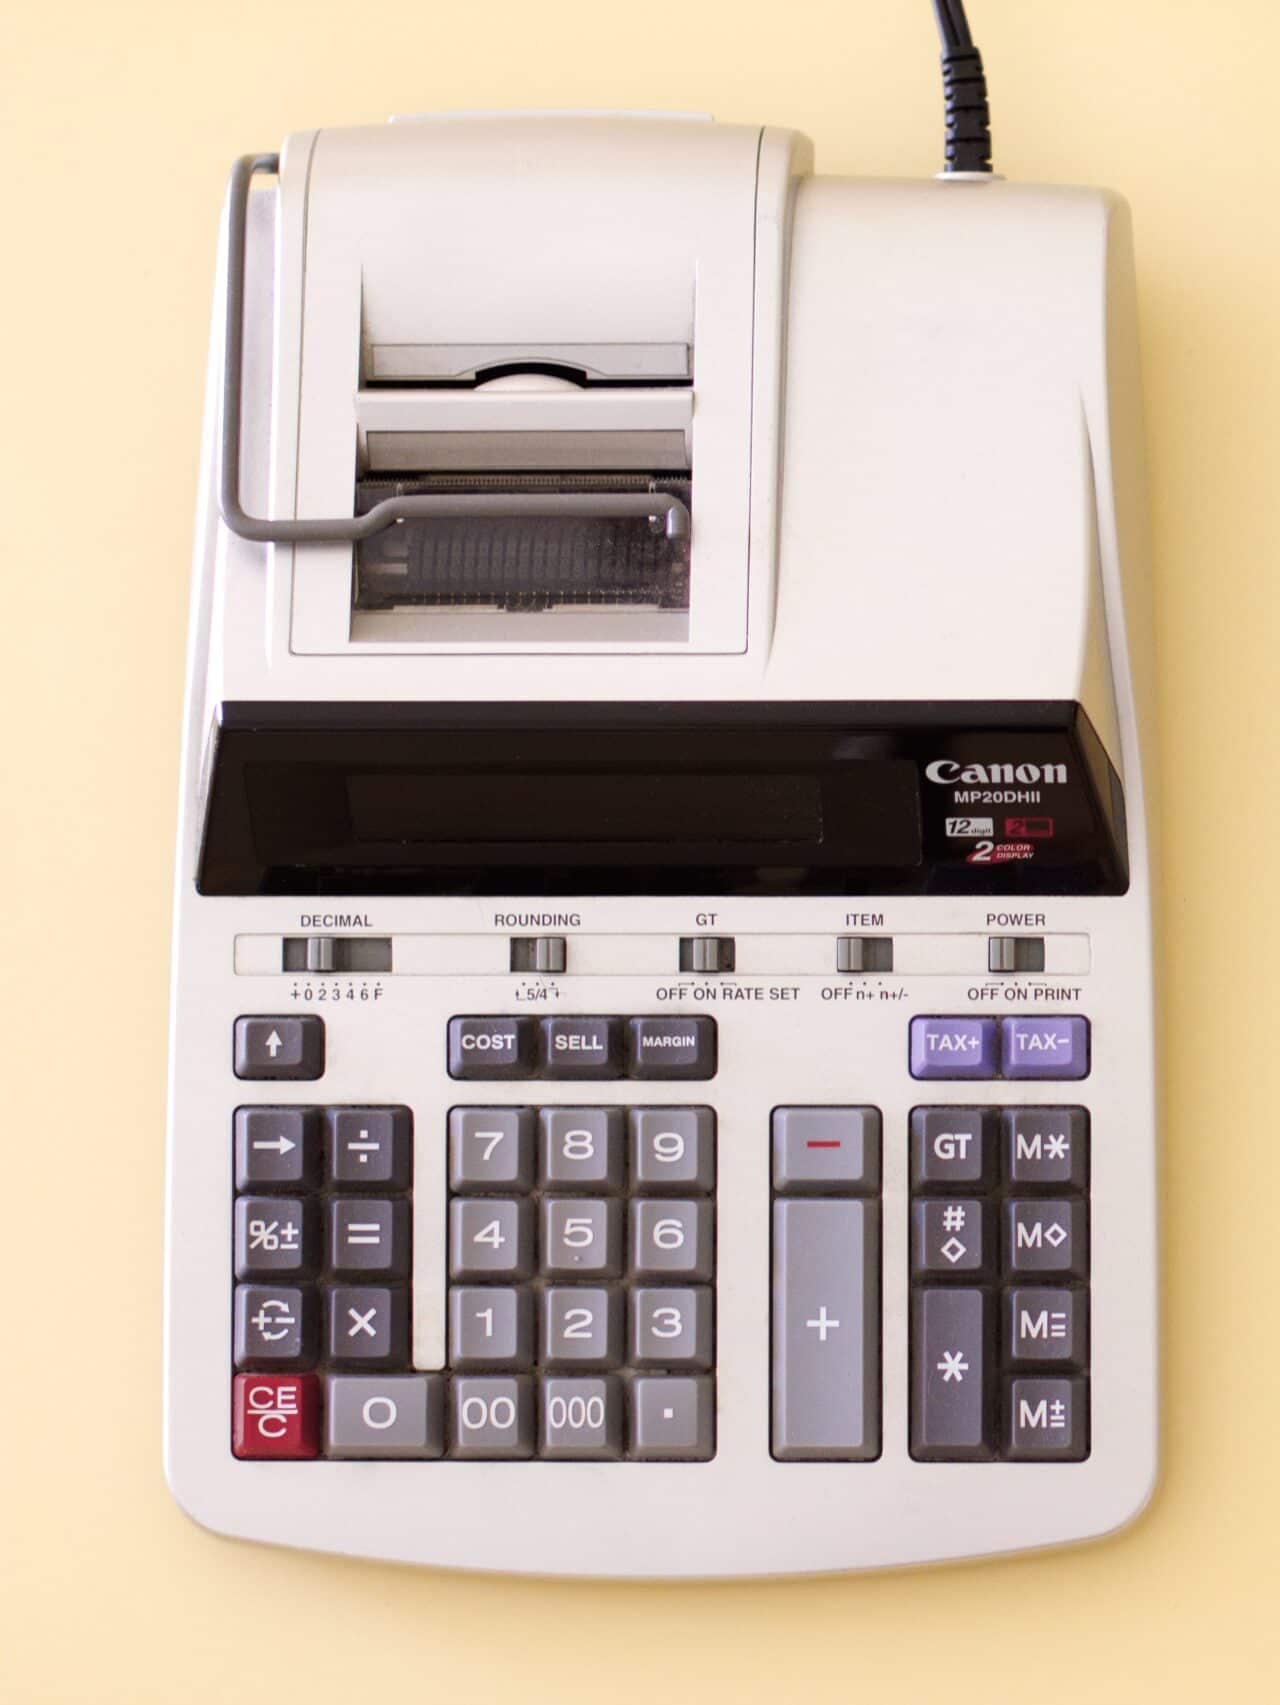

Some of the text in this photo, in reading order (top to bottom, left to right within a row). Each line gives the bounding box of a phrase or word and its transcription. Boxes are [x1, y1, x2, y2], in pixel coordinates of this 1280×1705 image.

[926, 760, 1067, 784] Canon
[955, 791, 1040, 803] MP20DHII
[948, 819, 971, 834] 12
[971, 841, 993, 861] 2
[301, 915, 372, 927] DECIMAL
[495, 914, 580, 926] ROUNDING
[696, 914, 717, 926] GT
[846, 914, 883, 926] ITEM
[987, 914, 1045, 926] POWER
[656, 988, 800, 1000] OFF ON RATE SET
[821, 988, 907, 1000] OFF n+ n+/-
[968, 988, 1080, 1000] OFF ON PRINT
[461, 1034, 516, 1051] COST
[555, 1035, 603, 1050] SELL
[643, 1036, 695, 1047] MARGIN
[927, 1034, 979, 1051] TAX+
[475, 1132, 504, 1160] 7
[563, 1130, 594, 1159] 8
[654, 1133, 684, 1162] 9
[934, 1133, 972, 1159] GT
[474, 1220, 505, 1248] 4
[564, 1218, 593, 1247] 5
[654, 1219, 684, 1248] 6
[476, 1308, 492, 1336] 1
[564, 1309, 593, 1338] 2
[652, 1308, 682, 1337] 3
[249, 1386, 297, 1409] CE
[363, 1397, 396, 1428] 0
[462, 1396, 515, 1429] 00
[550, 1396, 605, 1429] 000
[258, 1414, 287, 1438] C
